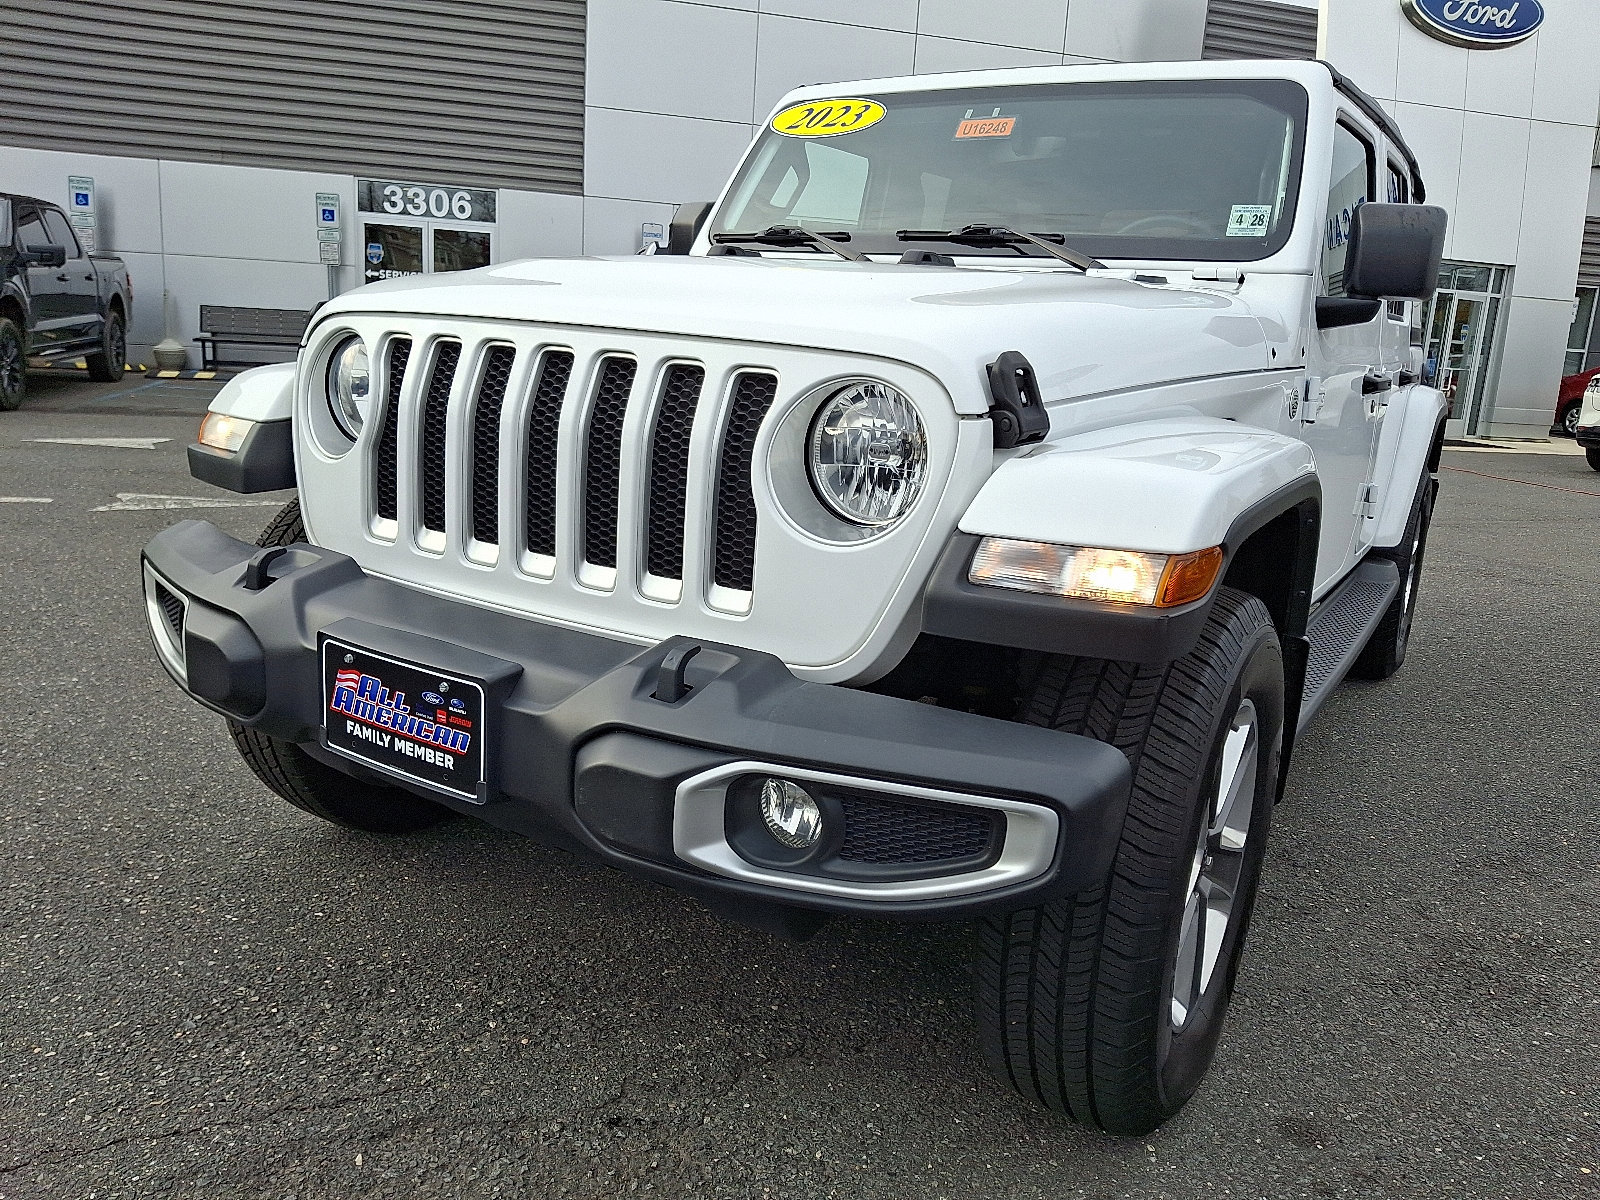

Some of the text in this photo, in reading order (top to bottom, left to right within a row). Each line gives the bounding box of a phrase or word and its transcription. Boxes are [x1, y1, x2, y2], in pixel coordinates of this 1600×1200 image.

[1443, 0, 1519, 28] Ford
[785, 104, 871, 130] 2023
[962, 120, 1008, 136] U16248
[383, 185, 472, 219] 3306
[1236, 214, 1265, 226] 4 28
[357, 674, 410, 713] ALL
[331, 684, 471, 754] AMERICAN
[346, 719, 455, 770] FAMILY MEMBER
